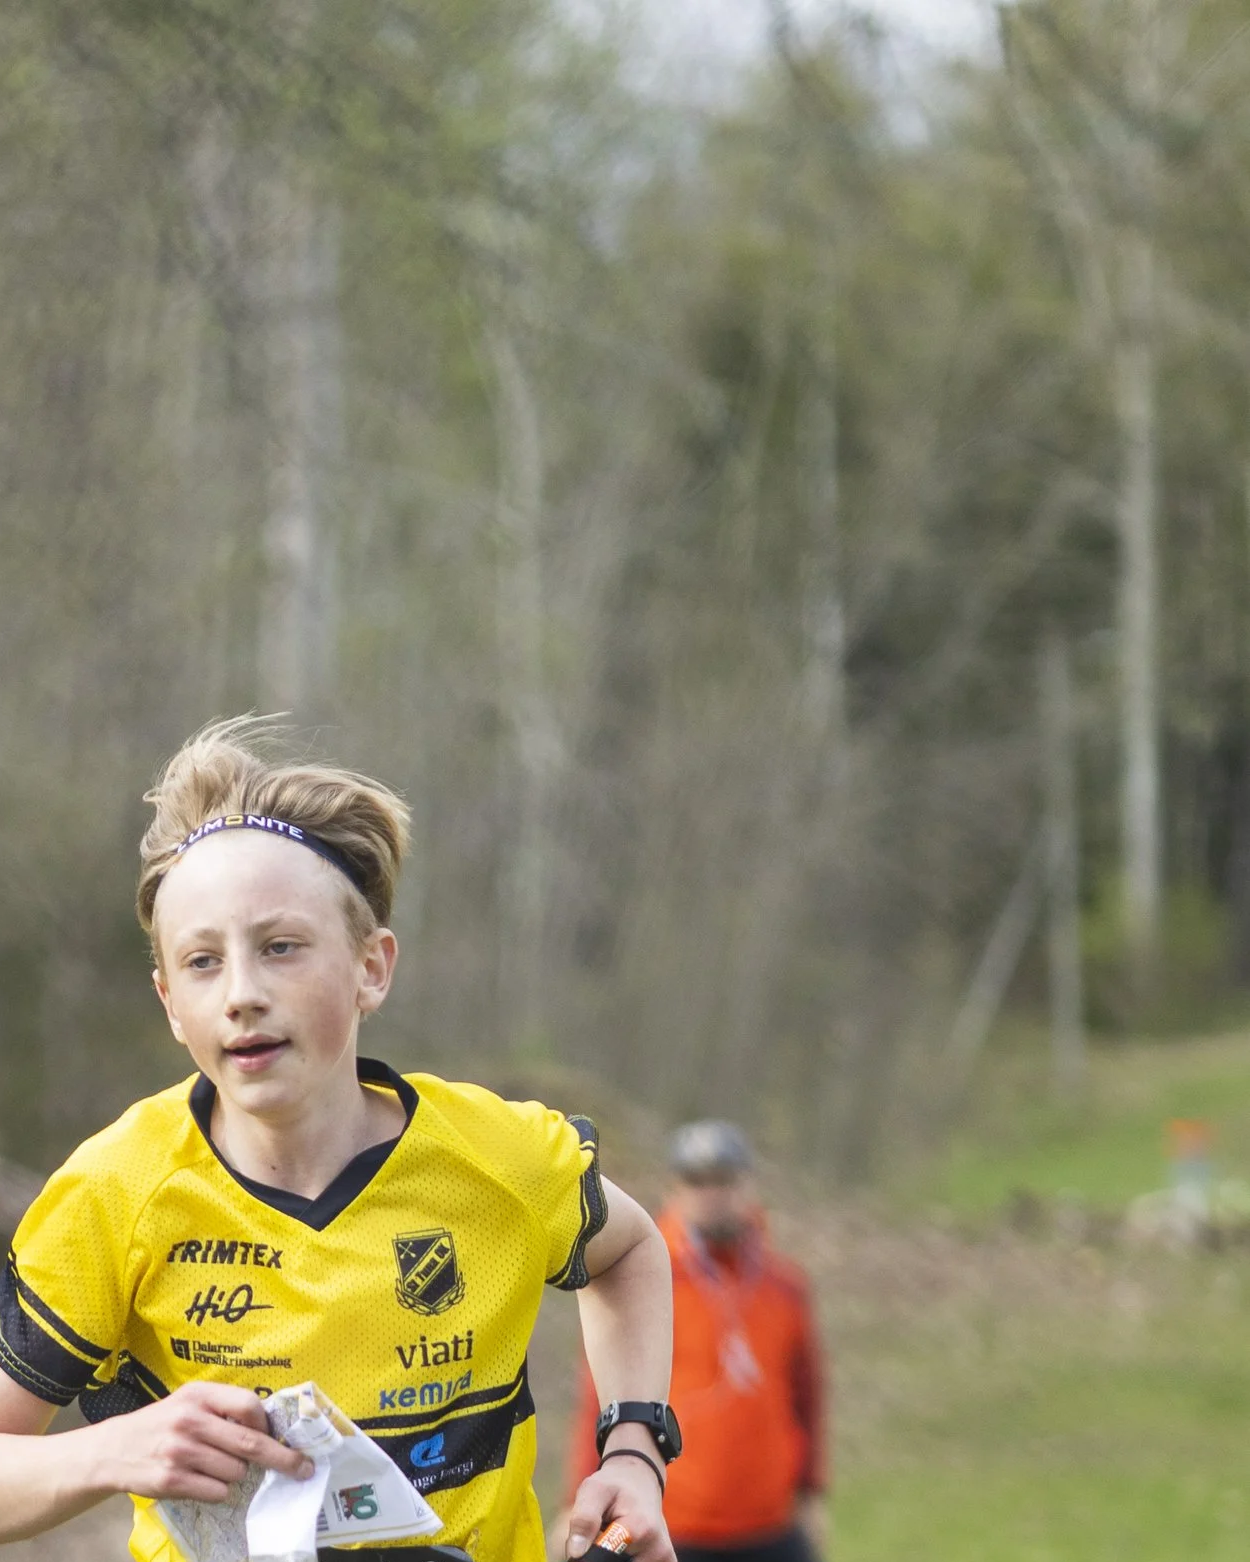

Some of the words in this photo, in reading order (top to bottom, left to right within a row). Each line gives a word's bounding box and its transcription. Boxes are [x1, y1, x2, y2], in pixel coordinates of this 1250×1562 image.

[166, 1240, 283, 1269] TRIMTEX
[192, 1341, 243, 1354] Dalarnas
[396, 1330, 473, 1370] viati
